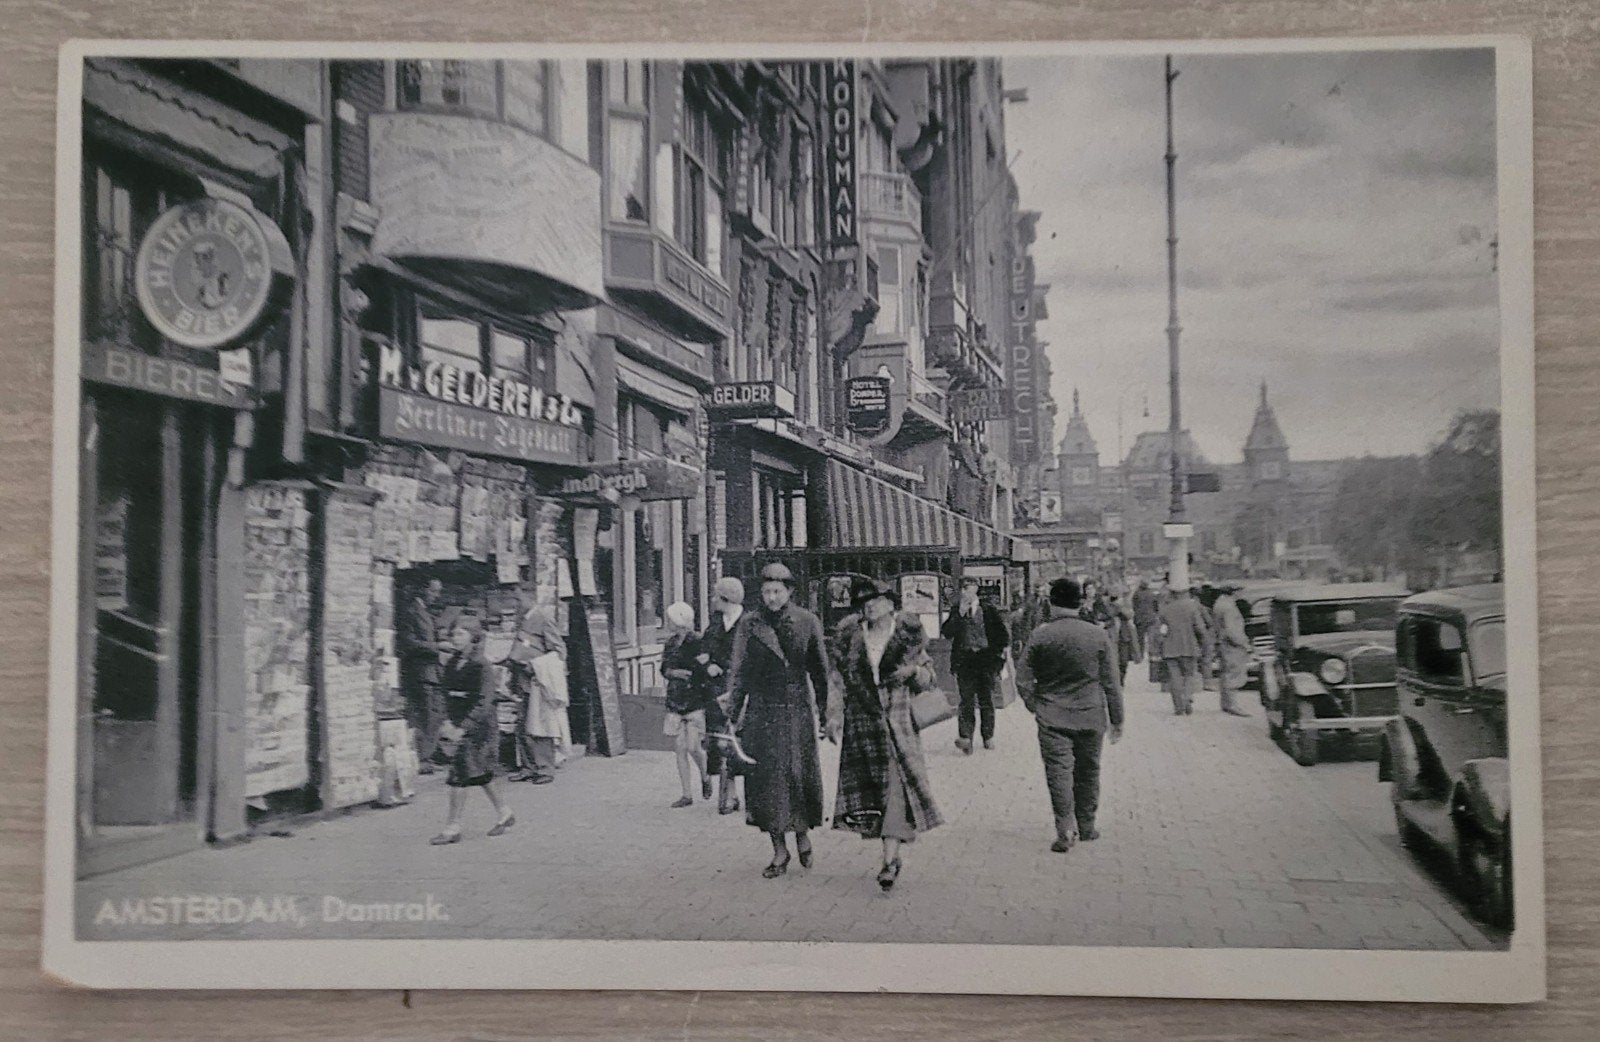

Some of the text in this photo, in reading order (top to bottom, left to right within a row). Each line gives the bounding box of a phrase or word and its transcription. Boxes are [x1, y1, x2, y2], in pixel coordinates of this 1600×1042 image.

[174, 304, 240, 335] BIER
[425, 360, 544, 420] GELDEREN
[713, 384, 771, 405] GELDER
[1011, 300, 1035, 461] UTRECHT
[395, 394, 488, 441] Berliner
